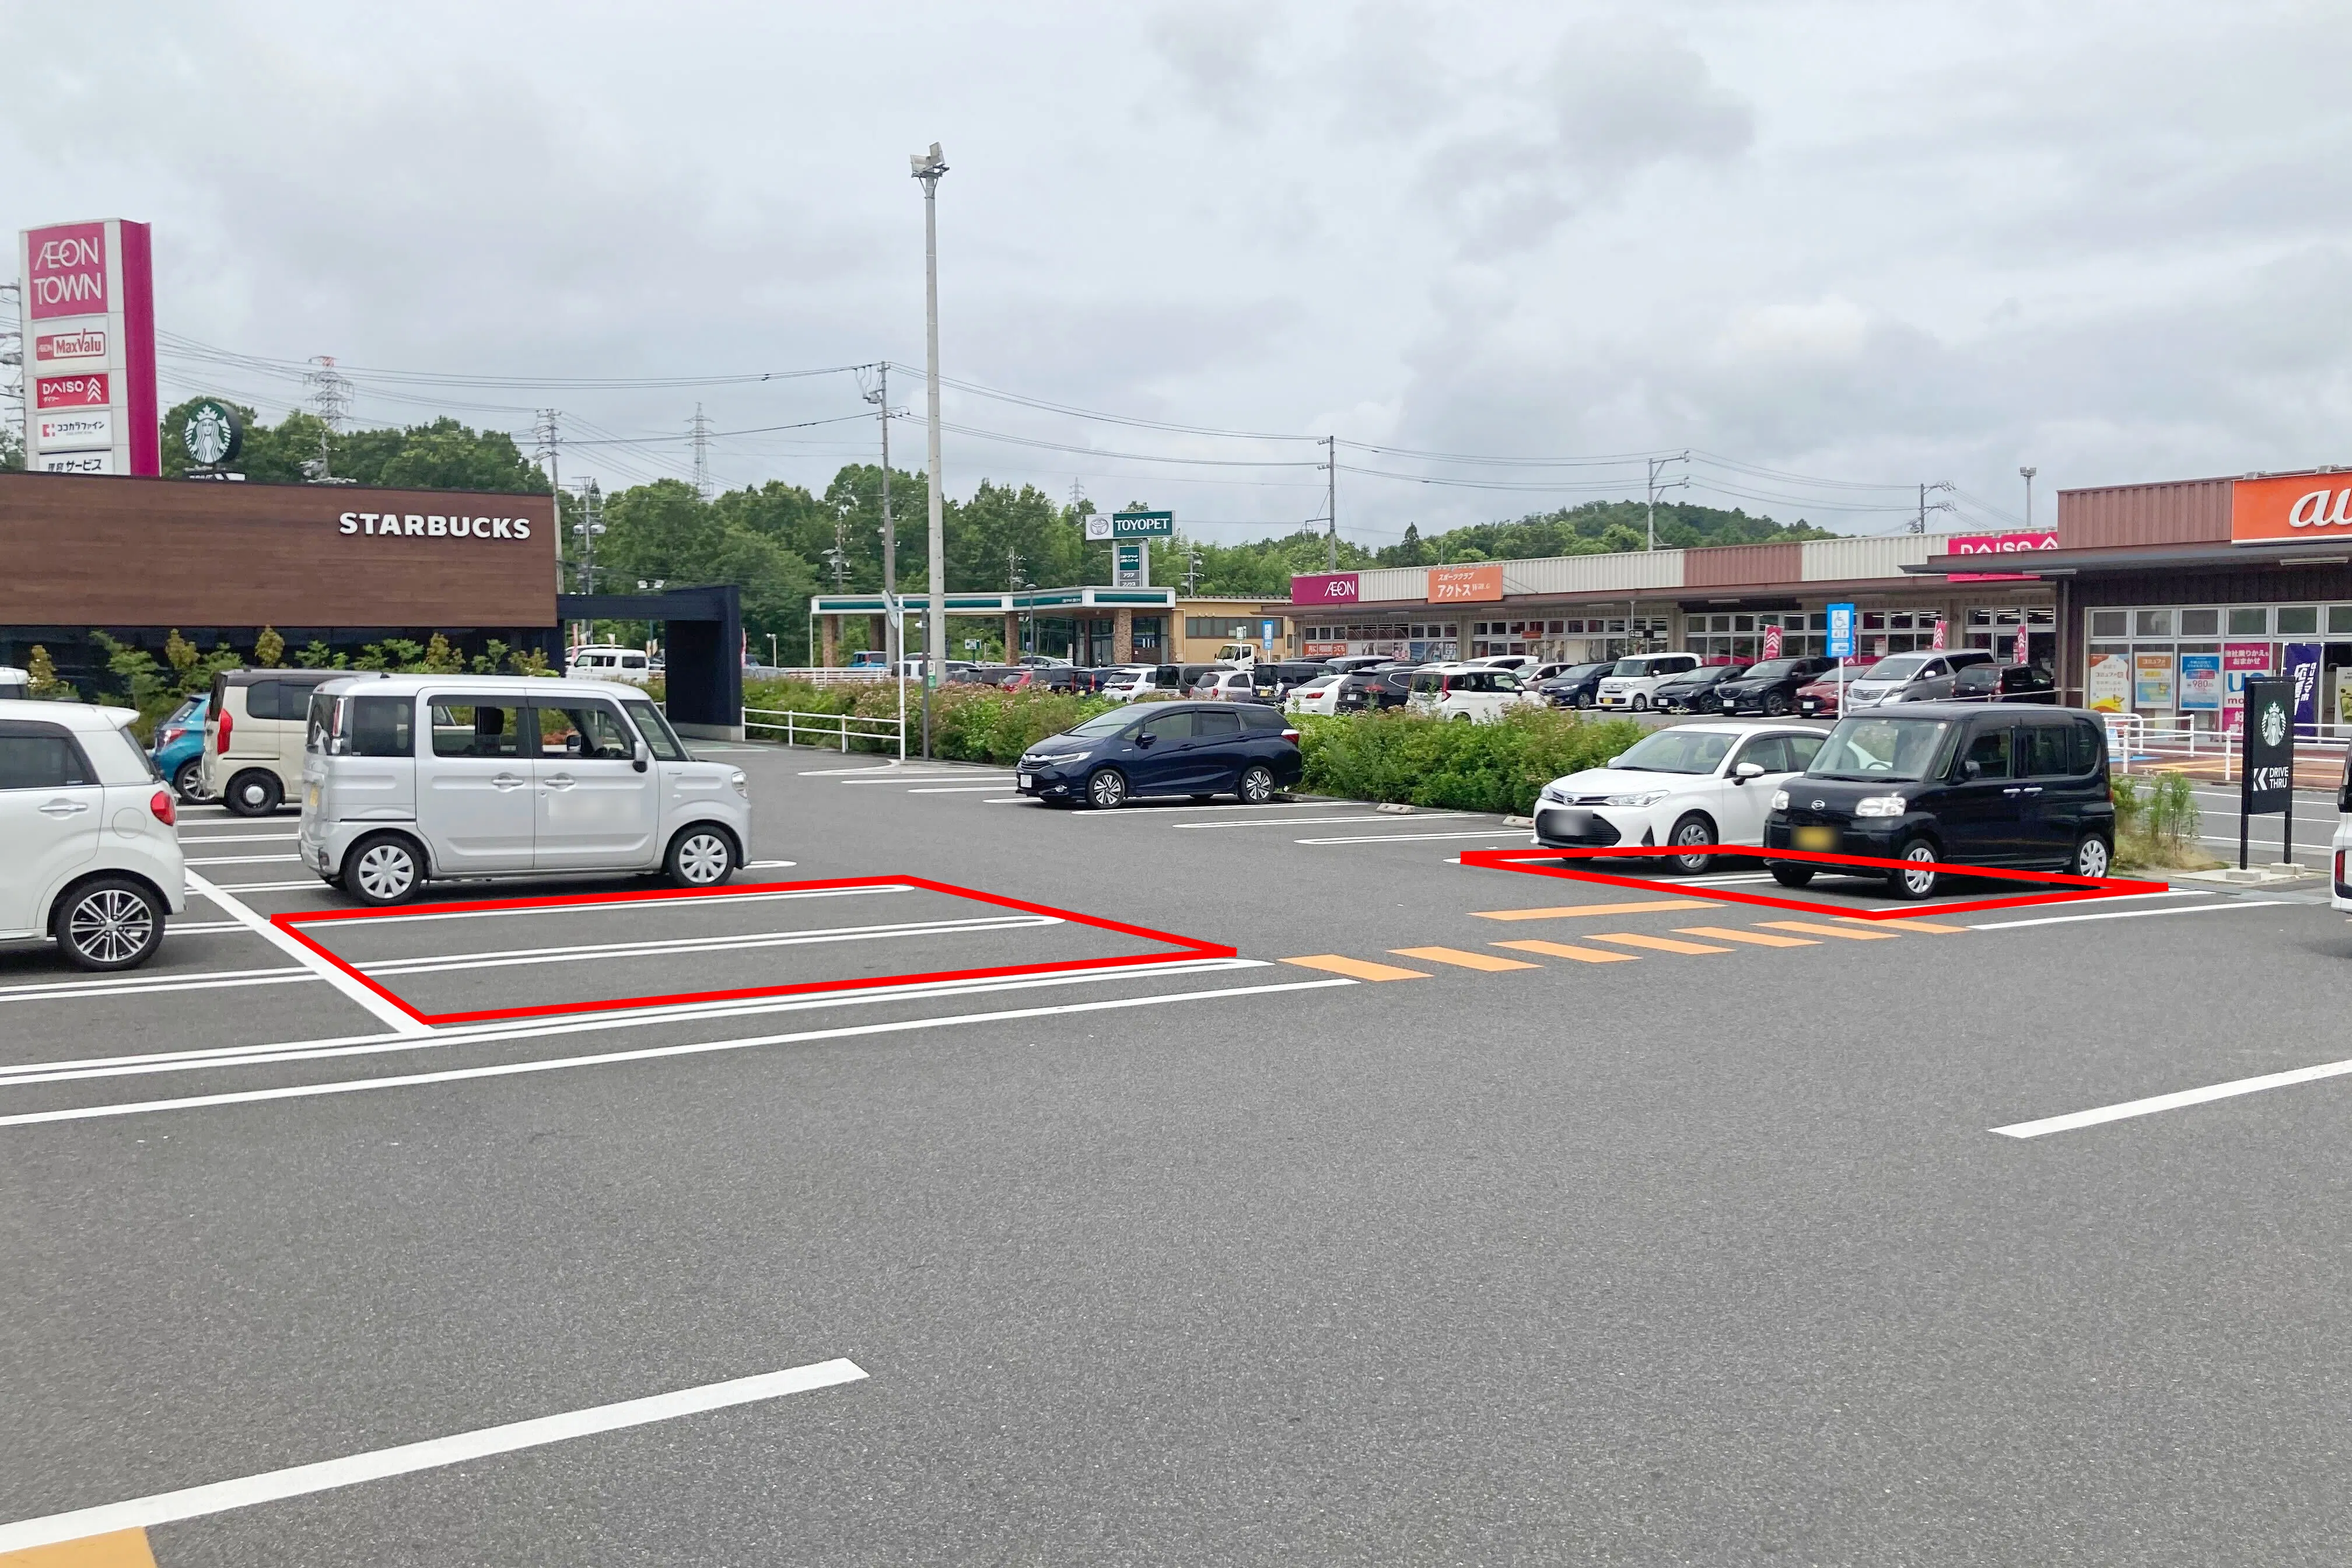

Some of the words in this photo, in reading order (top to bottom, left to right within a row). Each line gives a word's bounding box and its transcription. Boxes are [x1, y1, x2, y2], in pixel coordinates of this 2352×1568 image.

[33, 272, 102, 304] TOWN
[56, 328, 101, 354] MaxValu
[43, 380, 84, 395] DAISO
[57, 422, 104, 432] ココカラファイン
[339, 512, 531, 539] STARBUCKS
[1115, 518, 1170, 531] TOYOPET
[1437, 572, 1475, 582] スポーツクラブ
[1437, 583, 1471, 598] アクトス
[2269, 766, 2289, 778] DRIVE
[2269, 778, 2287, 789] THRU
